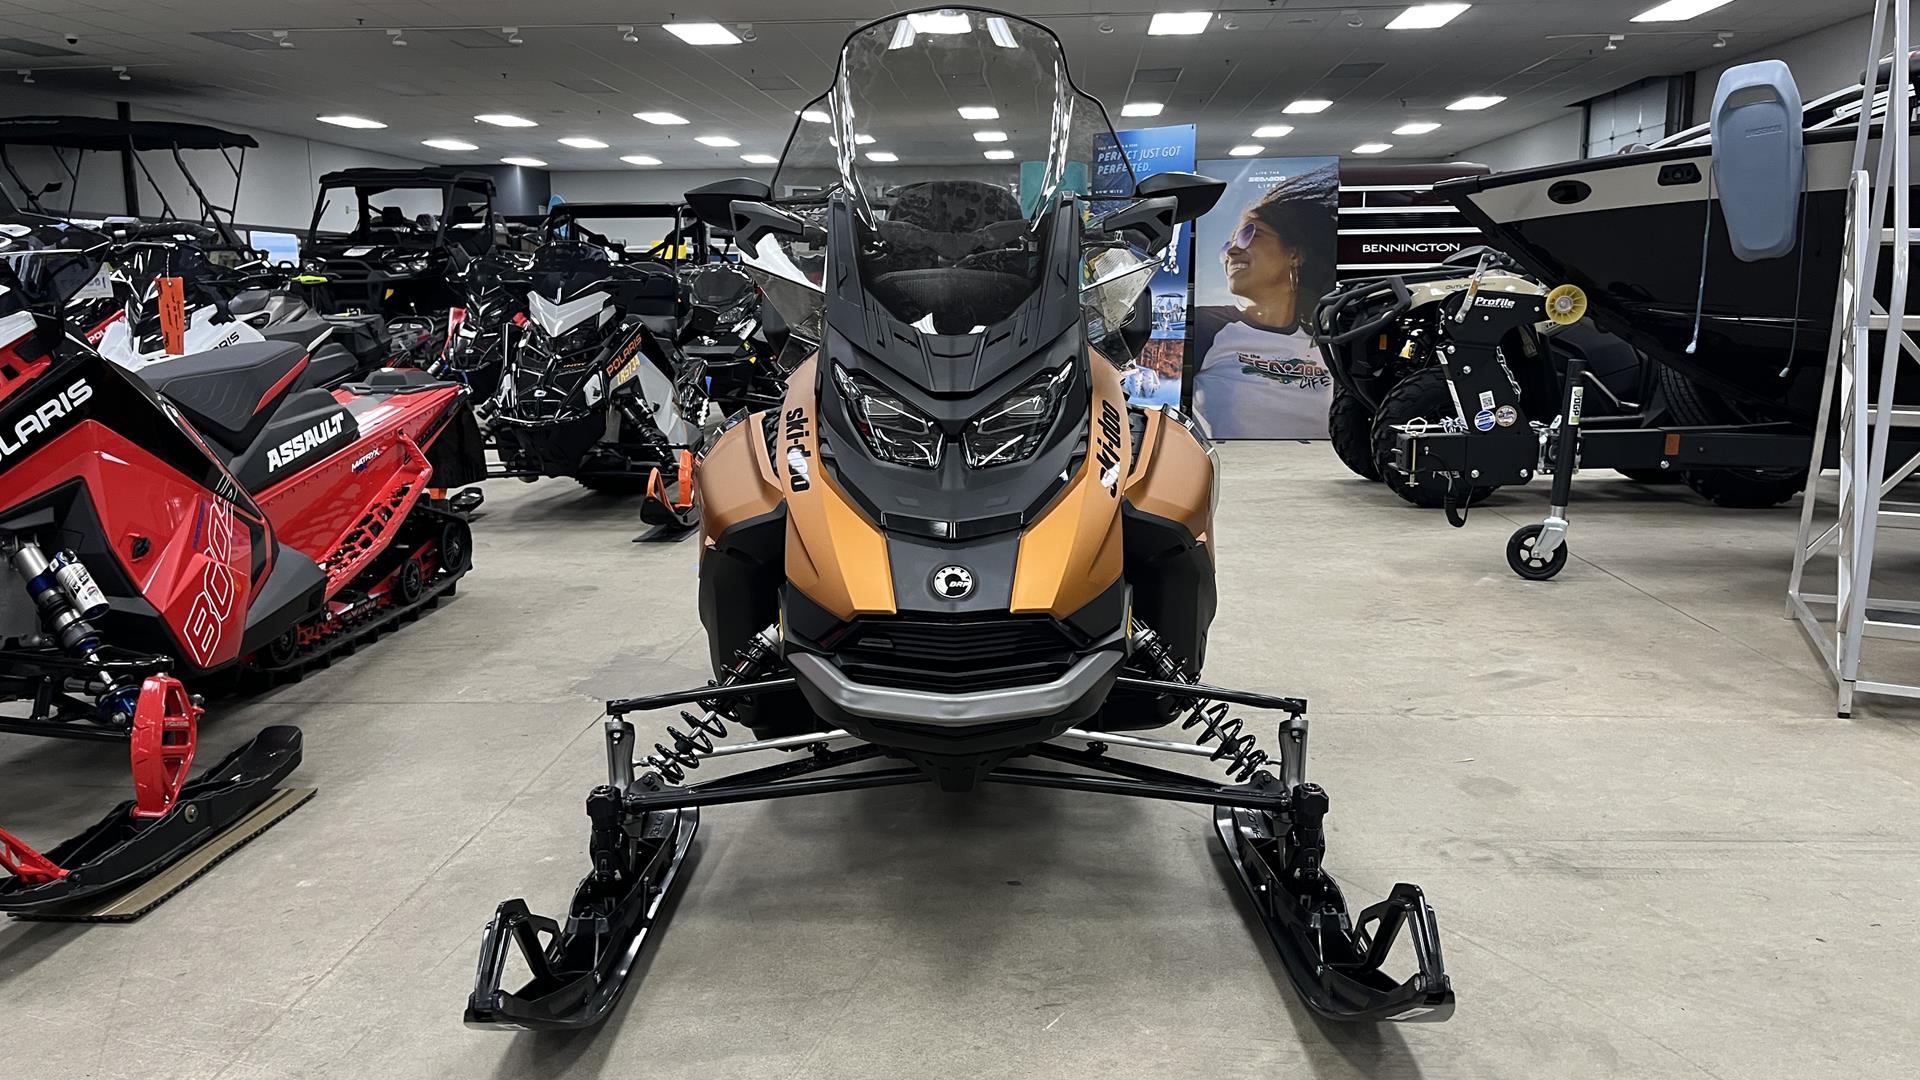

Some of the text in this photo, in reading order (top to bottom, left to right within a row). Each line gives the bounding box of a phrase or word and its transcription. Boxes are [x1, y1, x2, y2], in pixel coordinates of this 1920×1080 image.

[1138, 147, 1160, 162] JUST
[1161, 145, 1182, 157] GOT
[1097, 163, 1152, 176] PERFETED.
[1362, 243, 1460, 253] BENNINGTON
[1475, 296, 1516, 307] Profile
[606, 334, 642, 377] POLARIS
[1300, 376, 1331, 390] LIFE
[0, 377, 93, 462] LARIS
[266, 411, 344, 473] ASSAULT
